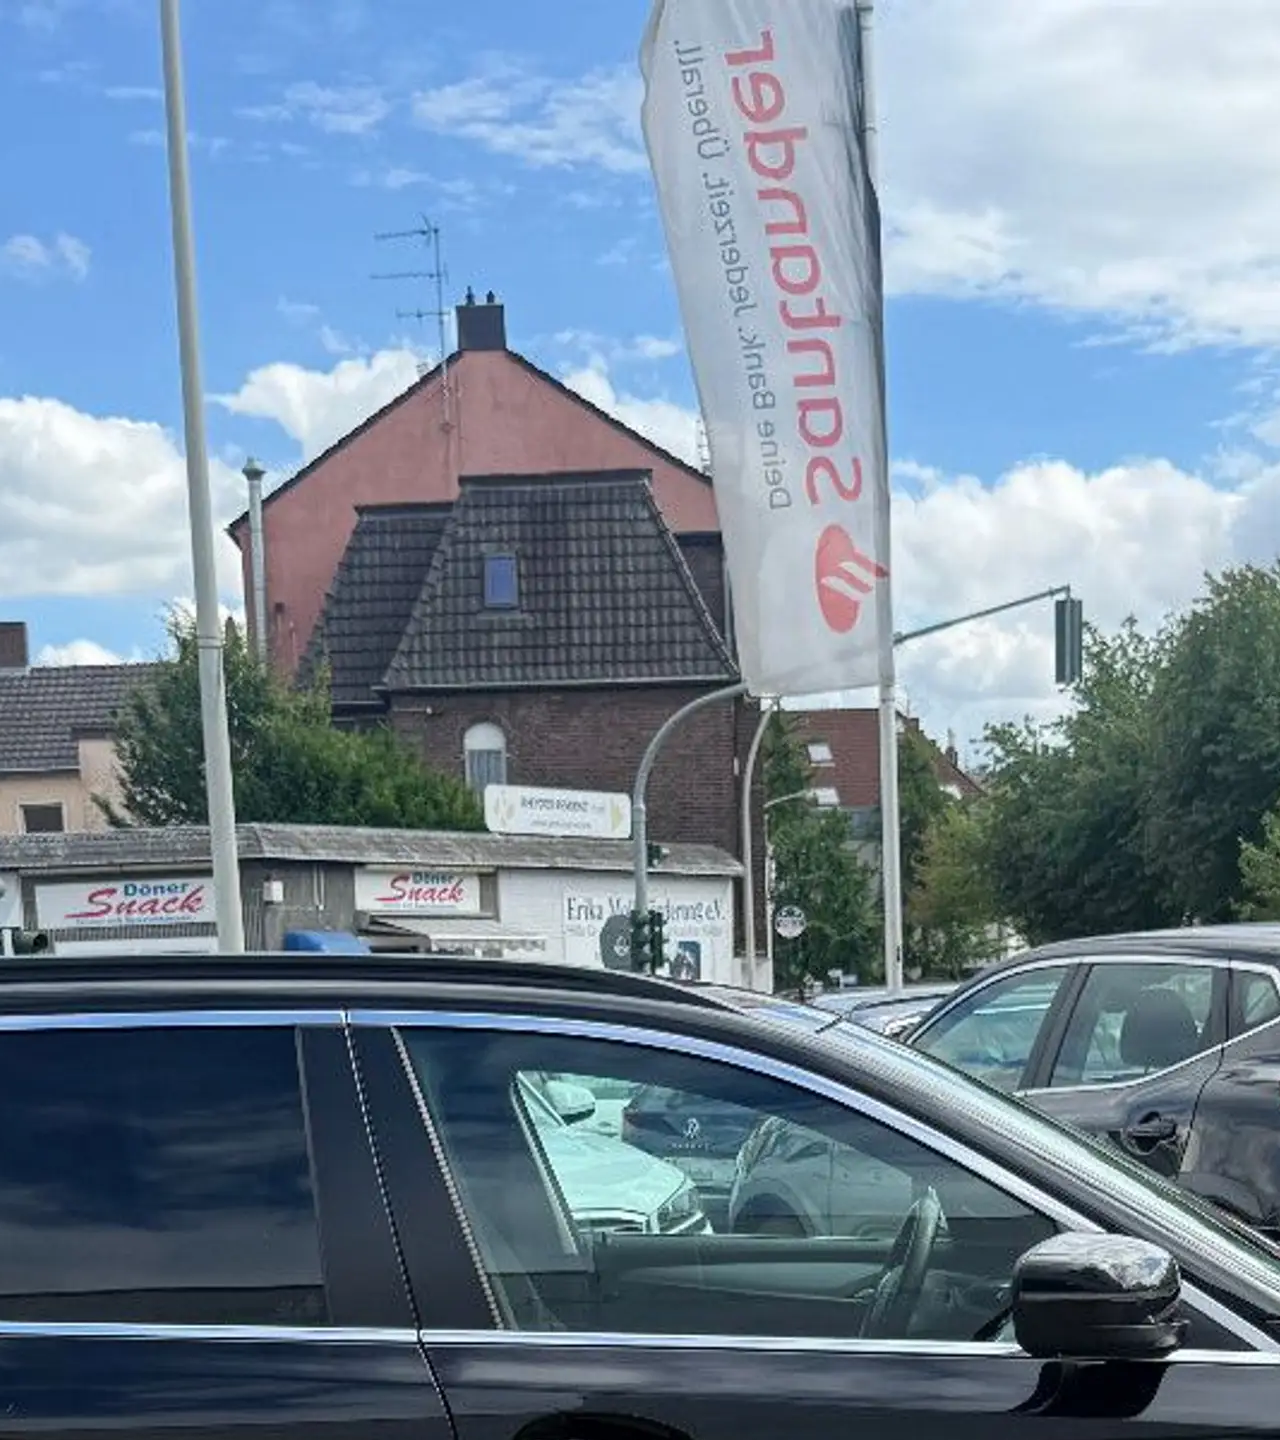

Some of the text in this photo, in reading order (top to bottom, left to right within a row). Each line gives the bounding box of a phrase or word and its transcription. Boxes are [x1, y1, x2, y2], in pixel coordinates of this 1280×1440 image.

[64, 884, 205, 919] Snack
[123, 882, 189, 897] Döner
[375, 874, 464, 903] Snack
